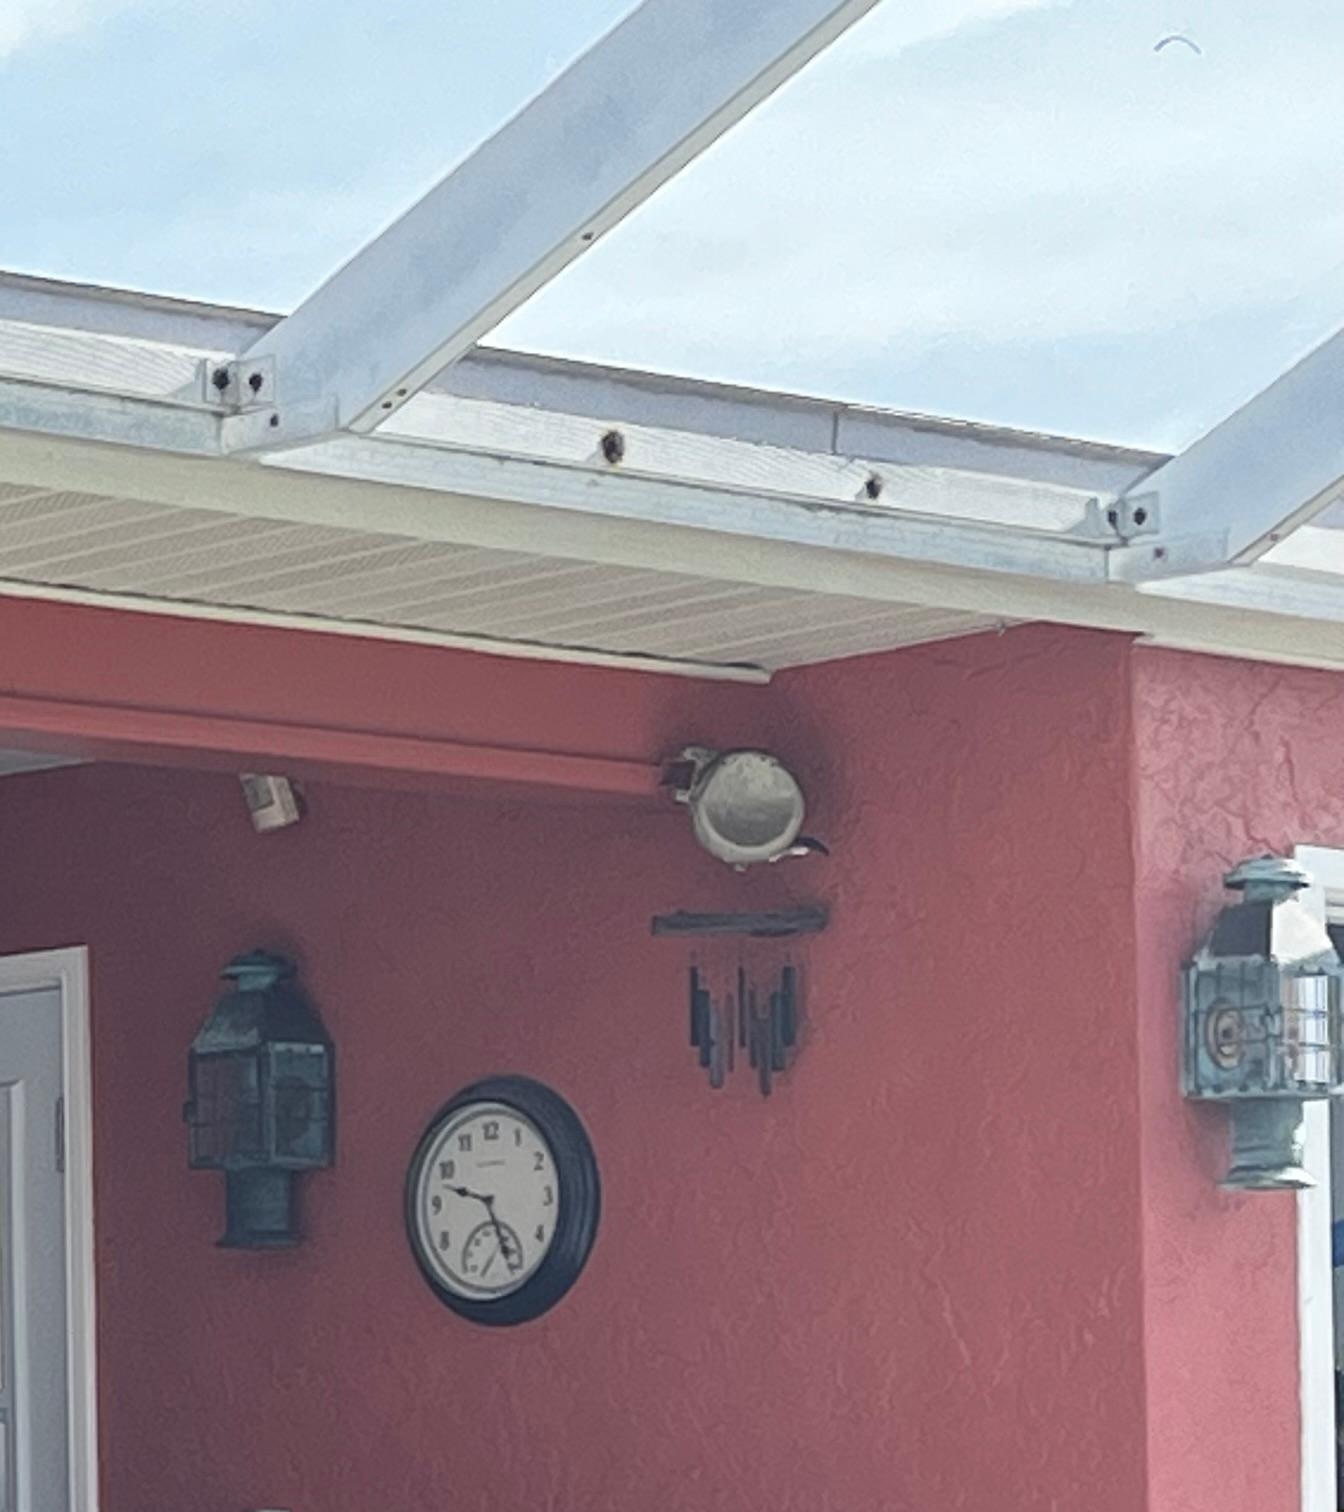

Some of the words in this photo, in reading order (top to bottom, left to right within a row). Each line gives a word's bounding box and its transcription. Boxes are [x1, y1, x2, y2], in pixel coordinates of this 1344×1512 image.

[482, 1121, 500, 1141] 12
[514, 1127, 522, 1147] 1
[457, 1133, 473, 1152] 11
[439, 1159, 456, 1181] 10
[533, 1152, 545, 1172] 2
[431, 1195, 443, 1216] 9
[543, 1186, 554, 1207] 3
[439, 1230, 450, 1251] 8
[534, 1224, 545, 1243] 4
